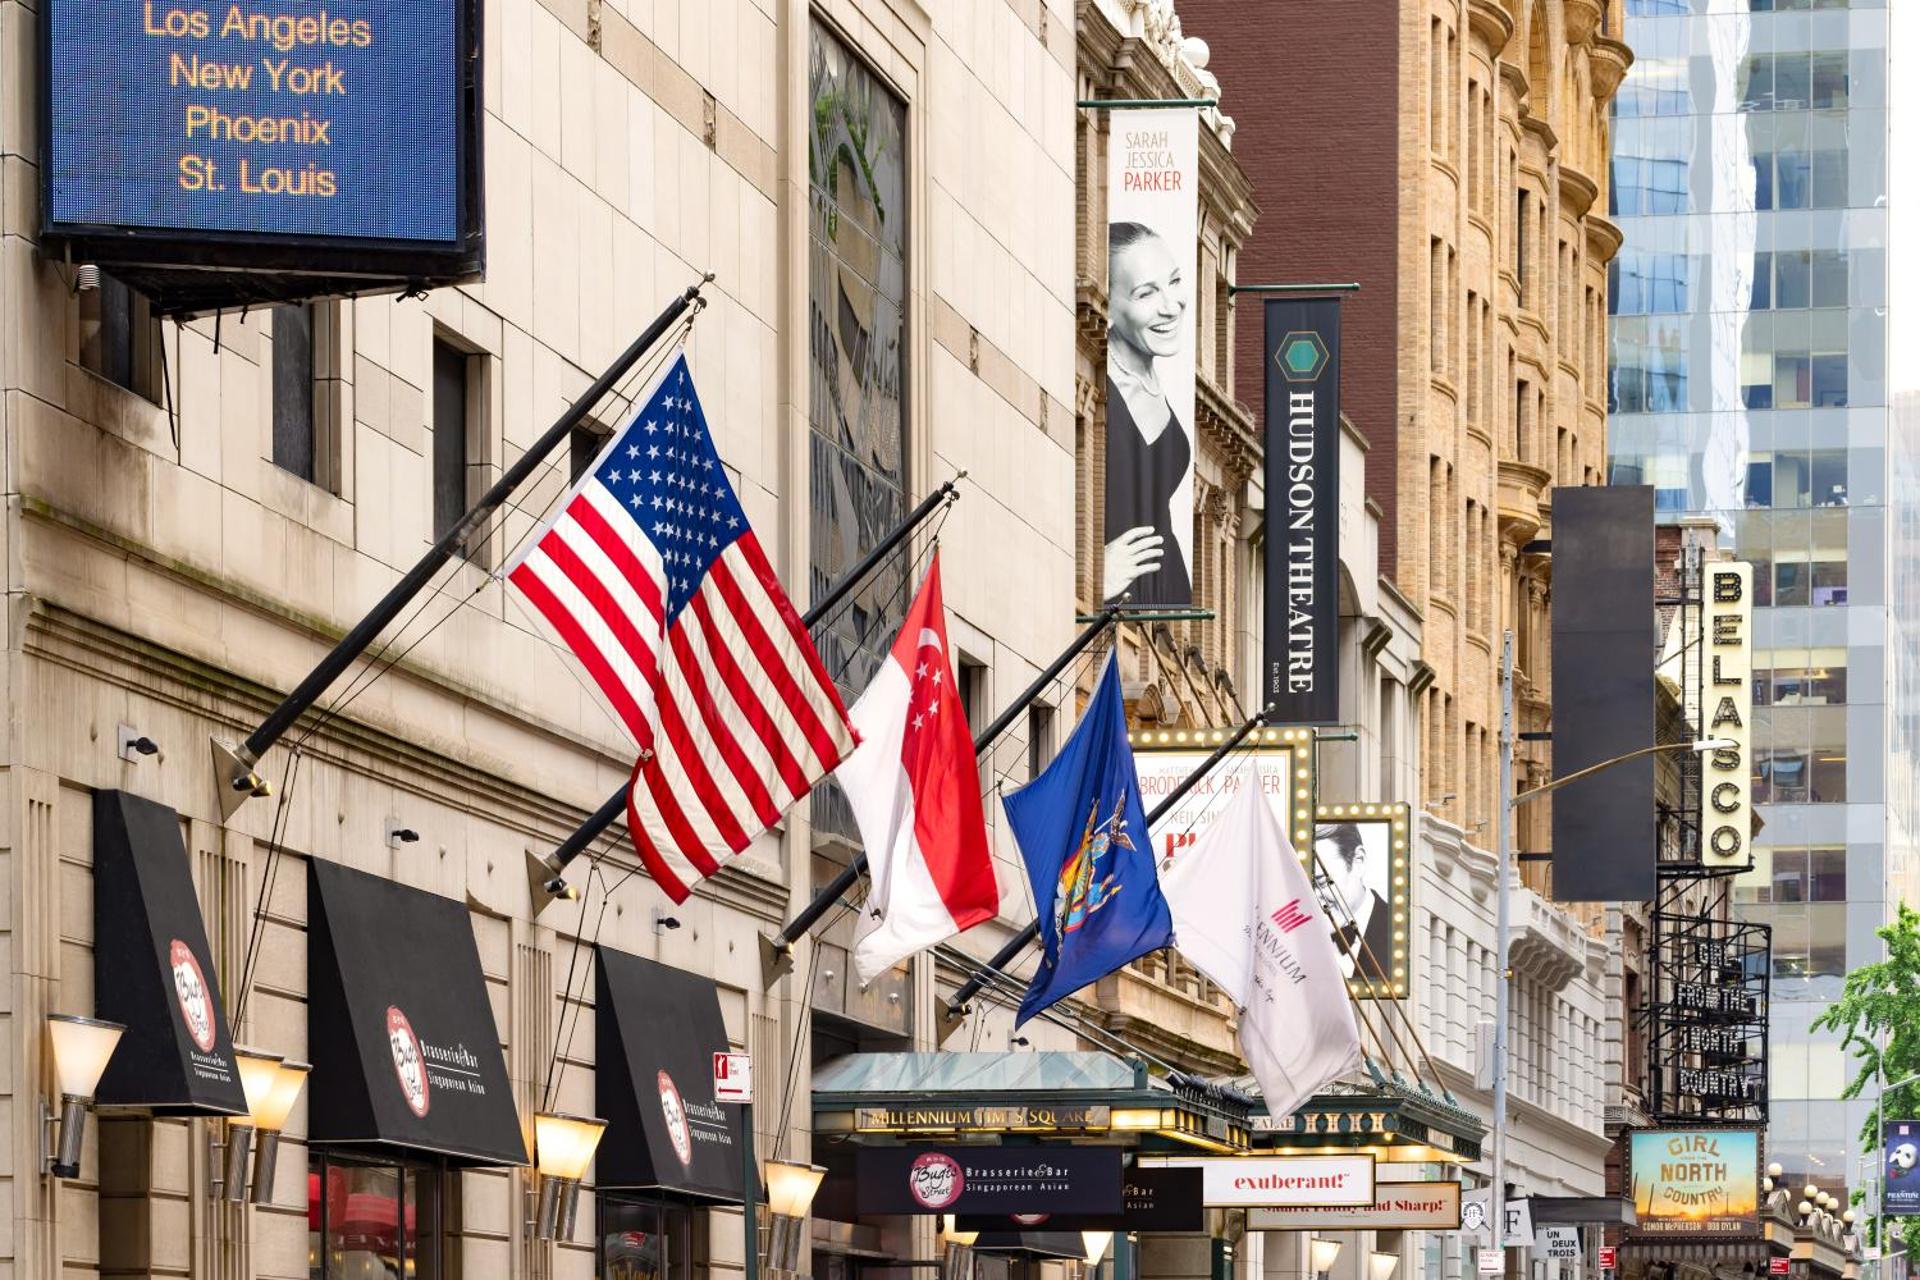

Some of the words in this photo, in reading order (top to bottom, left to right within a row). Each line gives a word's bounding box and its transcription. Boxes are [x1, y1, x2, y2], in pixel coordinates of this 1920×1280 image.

[144, 0, 209, 38] Los
[221, 5, 372, 51] Angeles
[170, 53, 254, 89] New
[262, 58, 347, 94] York
[185, 104, 331, 145] Phoenix
[1126, 131, 1168, 149] SARAH
[1125, 151, 1175, 169] JESSICA
[178, 154, 225, 191] St.
[239, 159, 337, 197] Louis
[1124, 170, 1182, 192] PARKER
[1288, 390, 1315, 532] HUDSON
[1288, 537, 1315, 694] THEATRE
[1711, 572, 1743, 858] BELASCO
[1224, 775, 1280, 795] PAER
[1720, 988, 1750, 1012] THE
[1690, 1027, 1739, 1053] NORTH
[1680, 1069, 1750, 1099] COUNTRY
[871, 1110, 971, 1125] MILLENNIUM
[976, 1110, 1024, 1124] TIMS
[1667, 1135, 1721, 1157] GIRL
[1660, 1163, 1727, 1182] NORTH
[966, 1183, 1033, 1193] Singaporean
[1040, 1182, 1070, 1191] Asian
[1663, 1185, 1724, 1206] COUNTRY
[1126, 1201, 1154, 1209] Asian
[1394, 1199, 1443, 1214] Sharp!
[1546, 1231, 1560, 1239] UN
[1721, 1221, 1741, 1231] DYLAN
[1547, 1249, 1576, 1257] TROIS
[1551, 1239, 1577, 1248] DEUX
